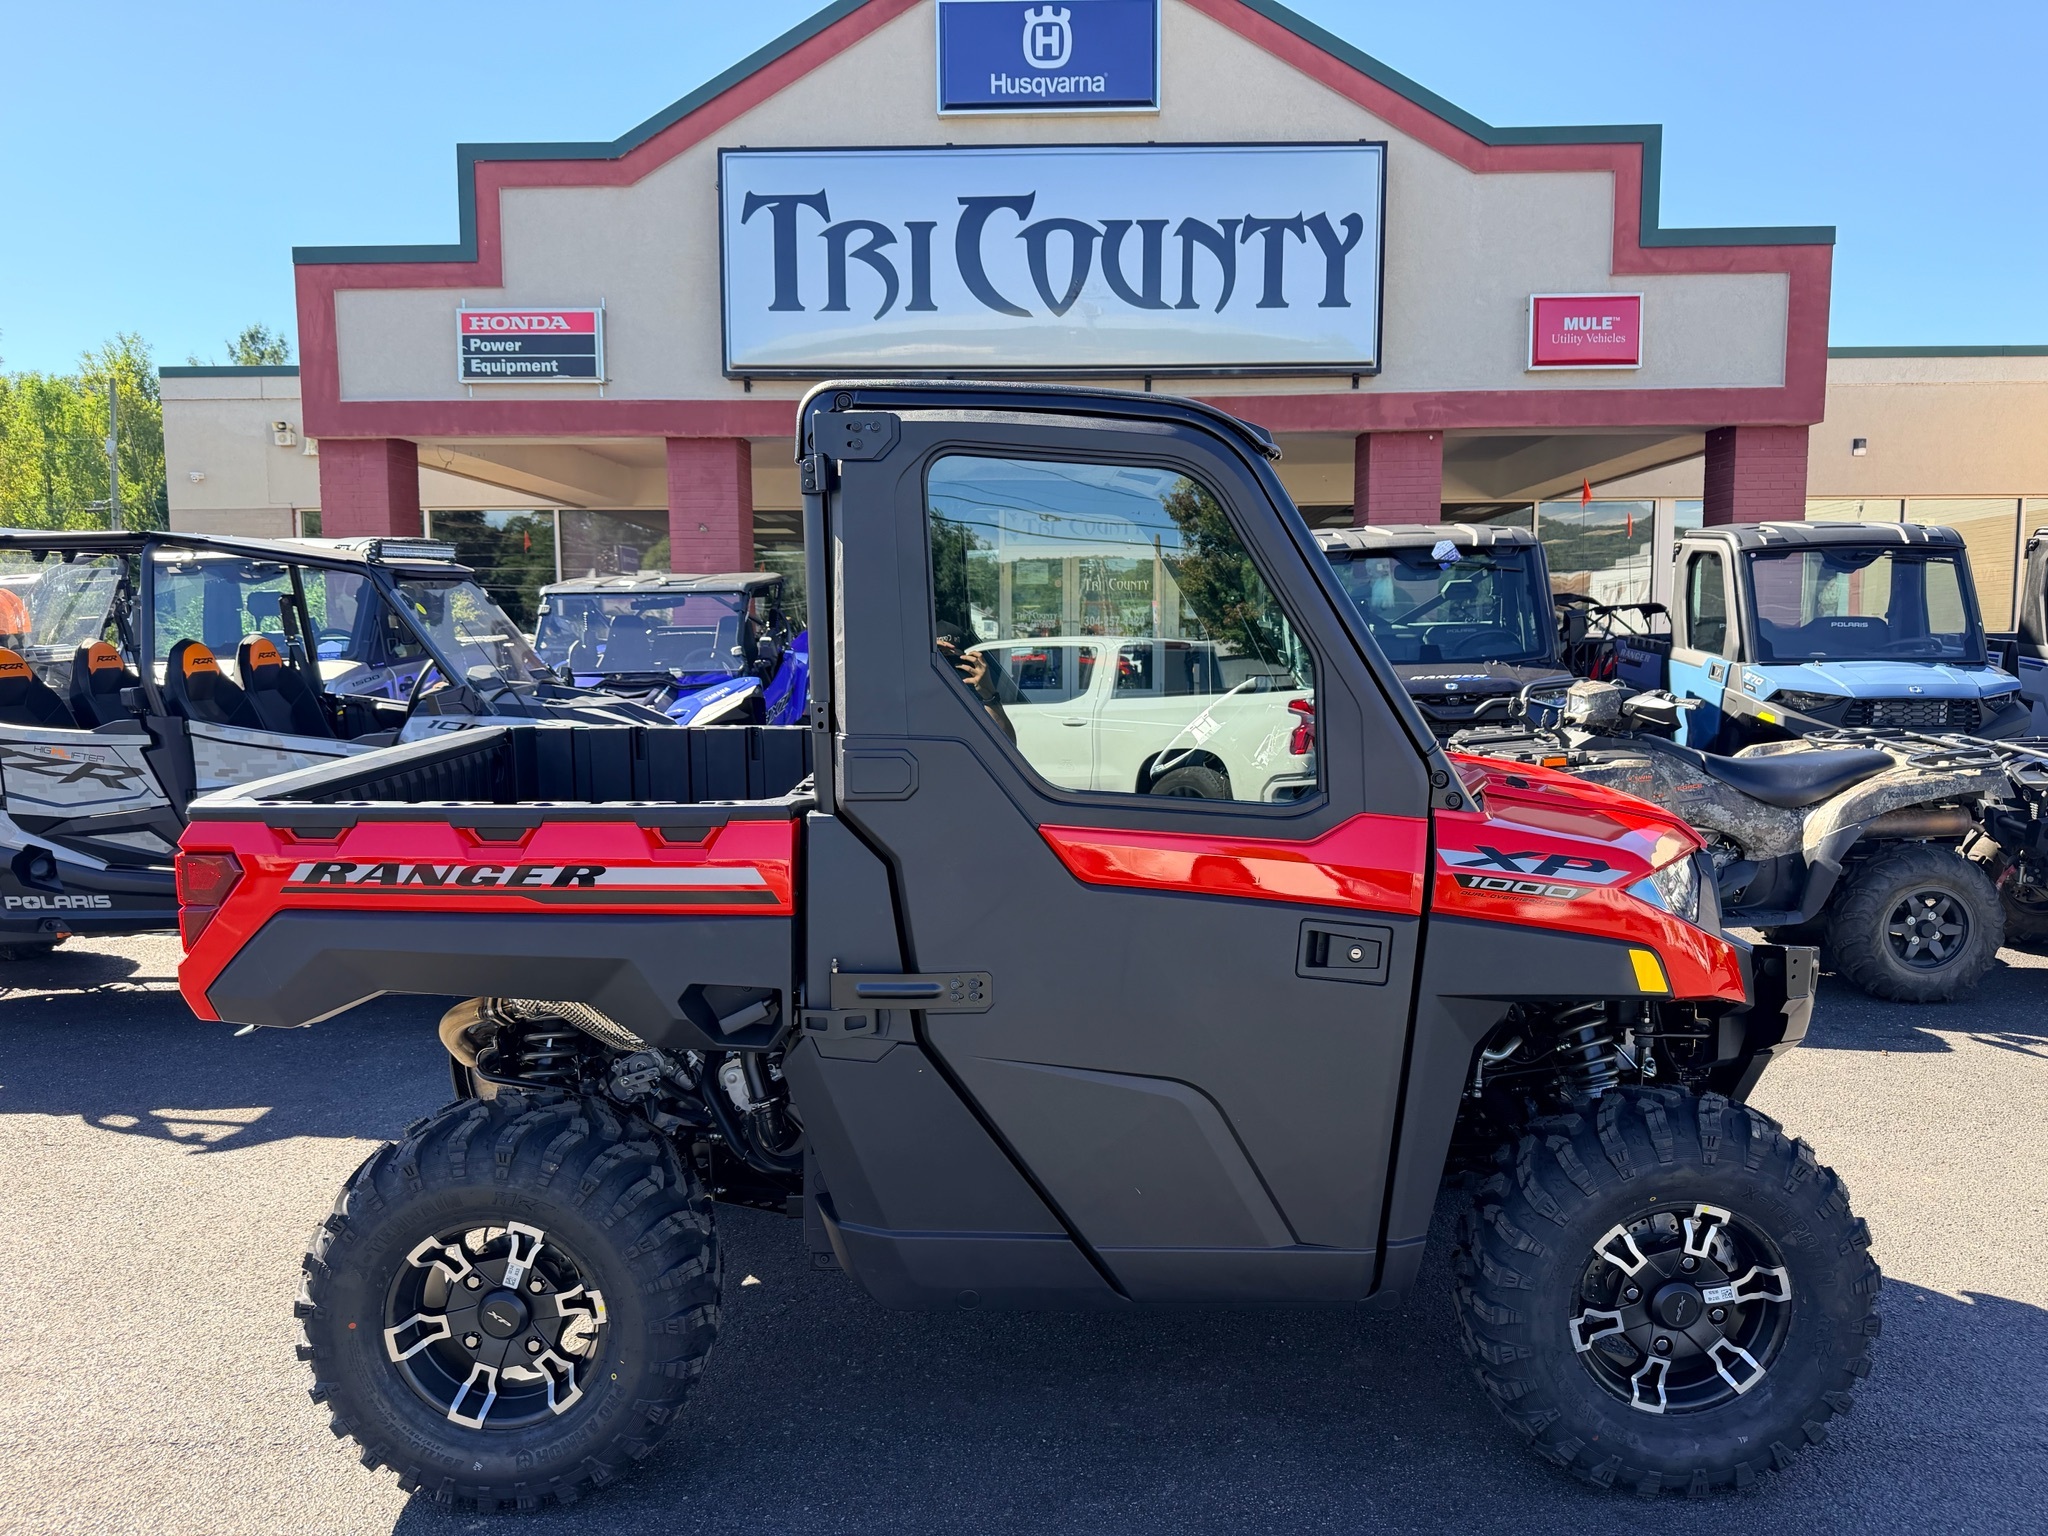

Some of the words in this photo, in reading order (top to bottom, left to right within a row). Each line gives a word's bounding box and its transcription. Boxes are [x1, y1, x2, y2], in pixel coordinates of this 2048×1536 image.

[990, 73, 1106, 97] Husqvarna
[469, 316, 571, 330] HONDA
[469, 338, 522, 352] Power
[1551, 333, 1583, 346] Utility
[1586, 333, 1626, 344] Vehicles
[471, 358, 559, 375] Equipment
[96, 654, 117, 663] RZR
[191, 656, 214, 666] RZR
[257, 651, 276, 661] RZR
[703, 686, 731, 702] YAMAHA
[1887, 787, 1934, 799] Kawasaki
[1453, 844, 1612, 876] XP
[302, 862, 606, 889] RANGER
[1460, 890, 1487, 898] DUAL
[1468, 876, 1578, 899] 1000
[4, 895, 112, 910] POLARIS
[486, 1310, 512, 1327] XP
